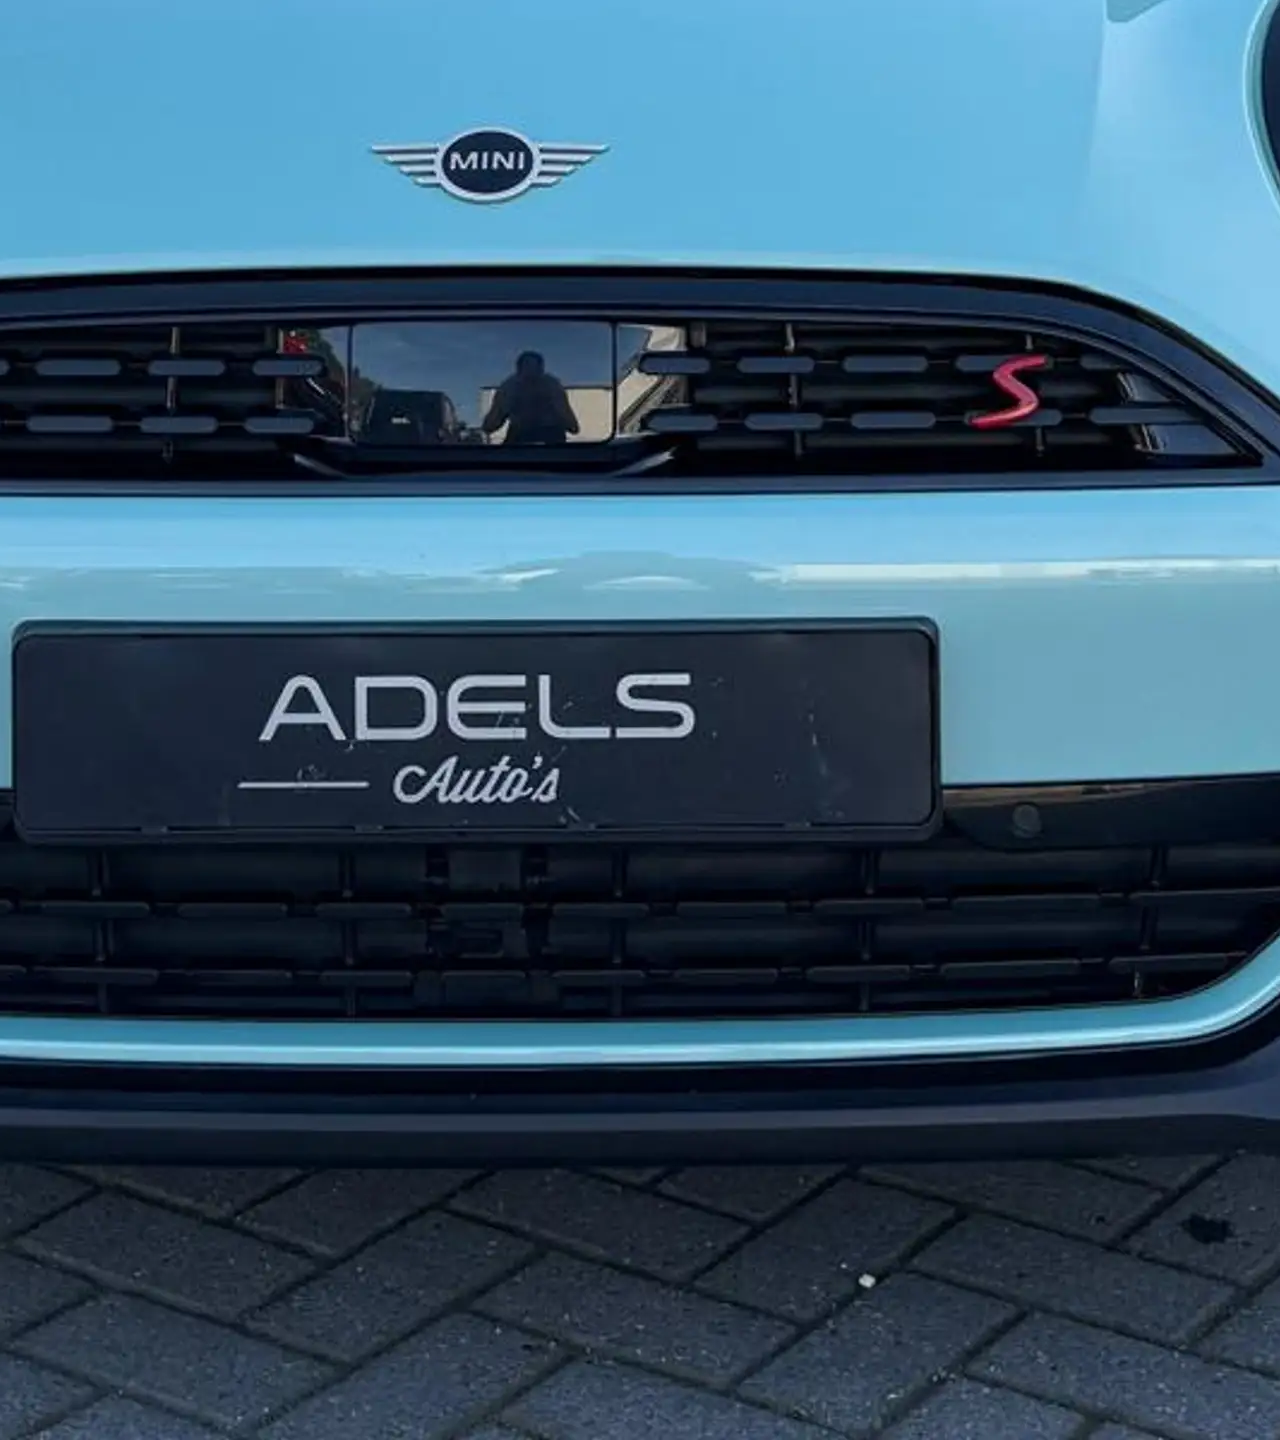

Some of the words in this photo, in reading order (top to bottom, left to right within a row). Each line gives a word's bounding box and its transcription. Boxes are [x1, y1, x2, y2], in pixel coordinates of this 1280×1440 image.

[449, 151, 525, 171] MINI
[970, 354, 1047, 430] S
[258, 673, 696, 742] ADELS
[392, 754, 561, 804] Auto's
